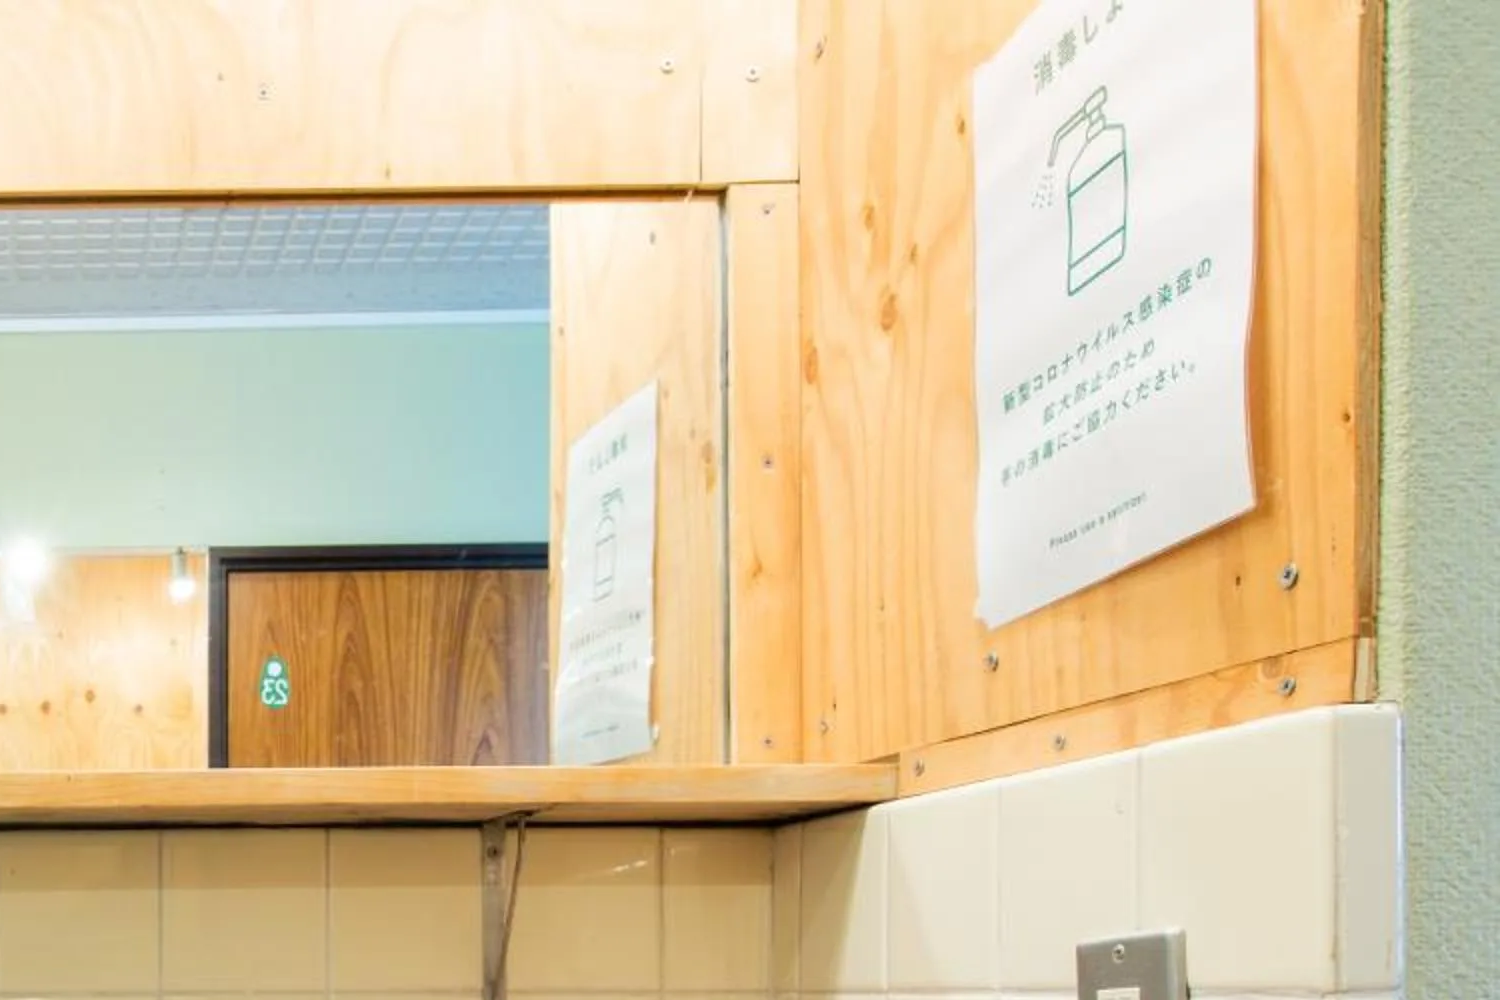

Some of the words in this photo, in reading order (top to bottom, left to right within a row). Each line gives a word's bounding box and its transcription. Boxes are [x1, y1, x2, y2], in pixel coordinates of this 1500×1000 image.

[1042, 338, 1156, 426] 拡大防止のため
